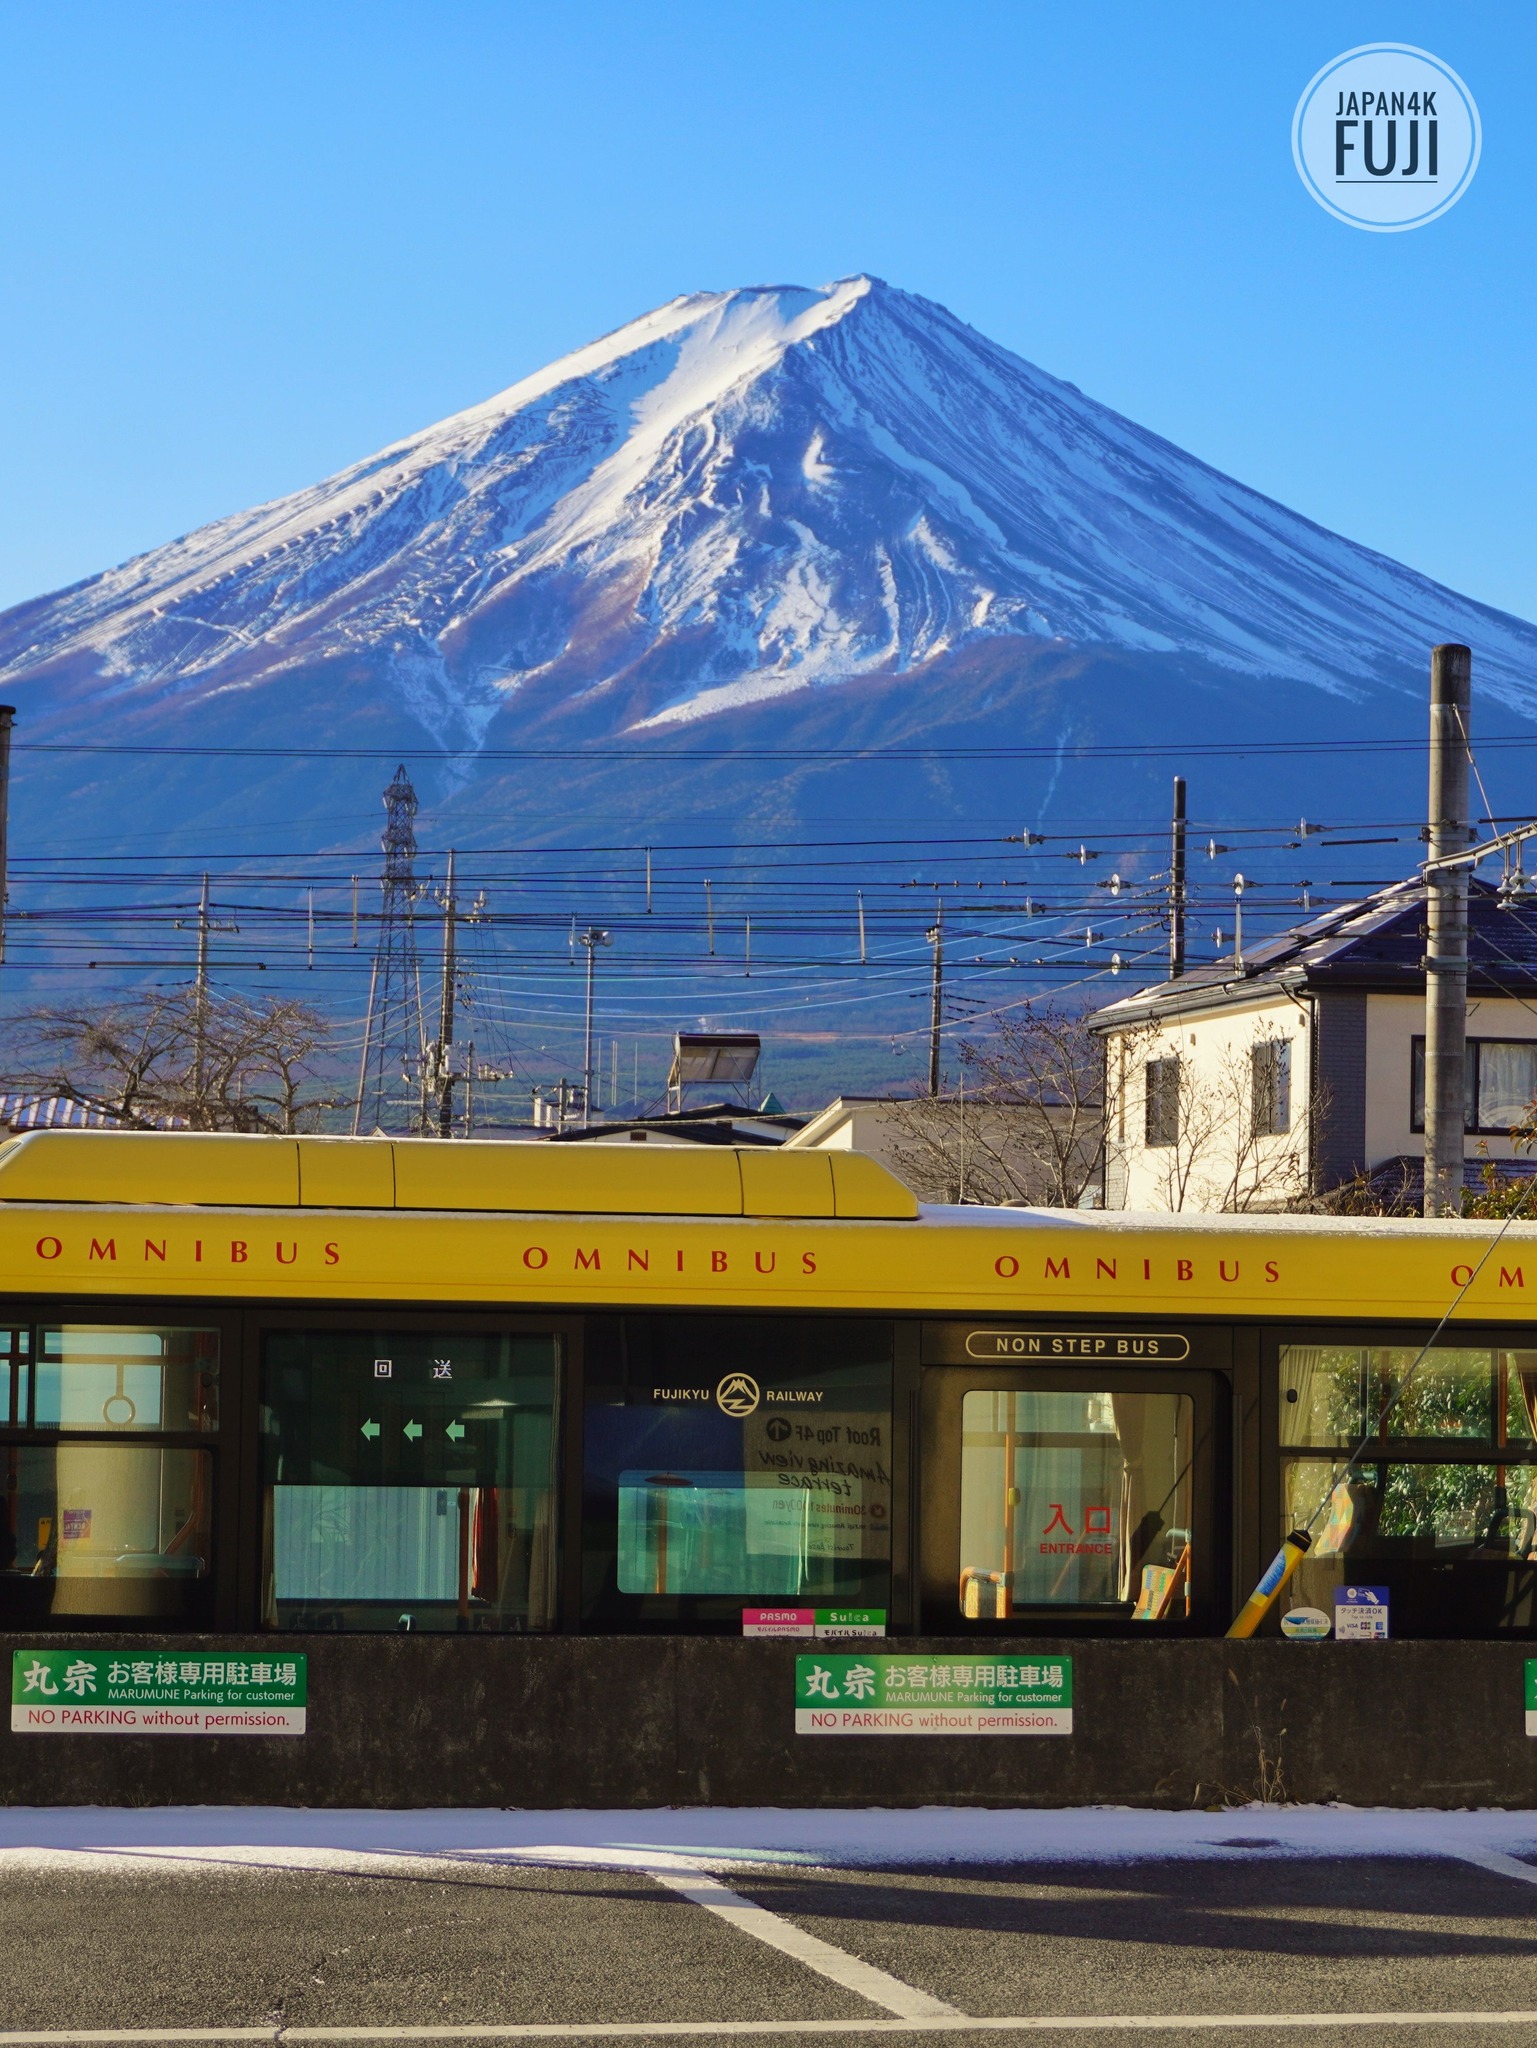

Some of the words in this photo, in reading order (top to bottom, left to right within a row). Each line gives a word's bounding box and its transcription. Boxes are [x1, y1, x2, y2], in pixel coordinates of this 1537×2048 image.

[36, 1236, 340, 1265] OMNIBUS
[522, 1246, 817, 1275] OMNIBUS
[994, 1254, 1281, 1283] OMNIBUS
[996, 1337, 1044, 1353] NON
[1051, 1338, 1106, 1354] STEP
[1117, 1339, 1160, 1355] BUS
[653, 1388, 710, 1400] FUJIKYU
[766, 1390, 823, 1402] RAILWAY
[1042, 1503, 1112, 1536] 入口
[1039, 1542, 1113, 1555] ENTRANCE
[759, 1612, 797, 1621] PASMO
[830, 1612, 870, 1622] Suica
[22, 1659, 98, 1697] 丸宗
[107, 1660, 297, 1686] お客様専用駐車場
[805, 1664, 876, 1700] 丸宗
[884, 1665, 1064, 1688] お客様専用駐車場
[107, 1688, 180, 1700] MARUMUNE
[184, 1689, 224, 1703] Parking
[227, 1689, 244, 1701] for
[246, 1691, 295, 1701] customer
[885, 1692, 954, 1702] MARUMUNE
[957, 1692, 995, 1705] Parking
[998, 1692, 1013, 1702] for
[1015, 1693, 1062, 1703] customer
[28, 1710, 56, 1724] NO
[61, 1710, 136, 1725] PARKING
[143, 1711, 199, 1725] without
[205, 1712, 290, 1729] permission.
[811, 1713, 837, 1727] NO
[842, 1713, 913, 1727] PARKING
[918, 1713, 973, 1727] without
[977, 1714, 1058, 1731] permission.
